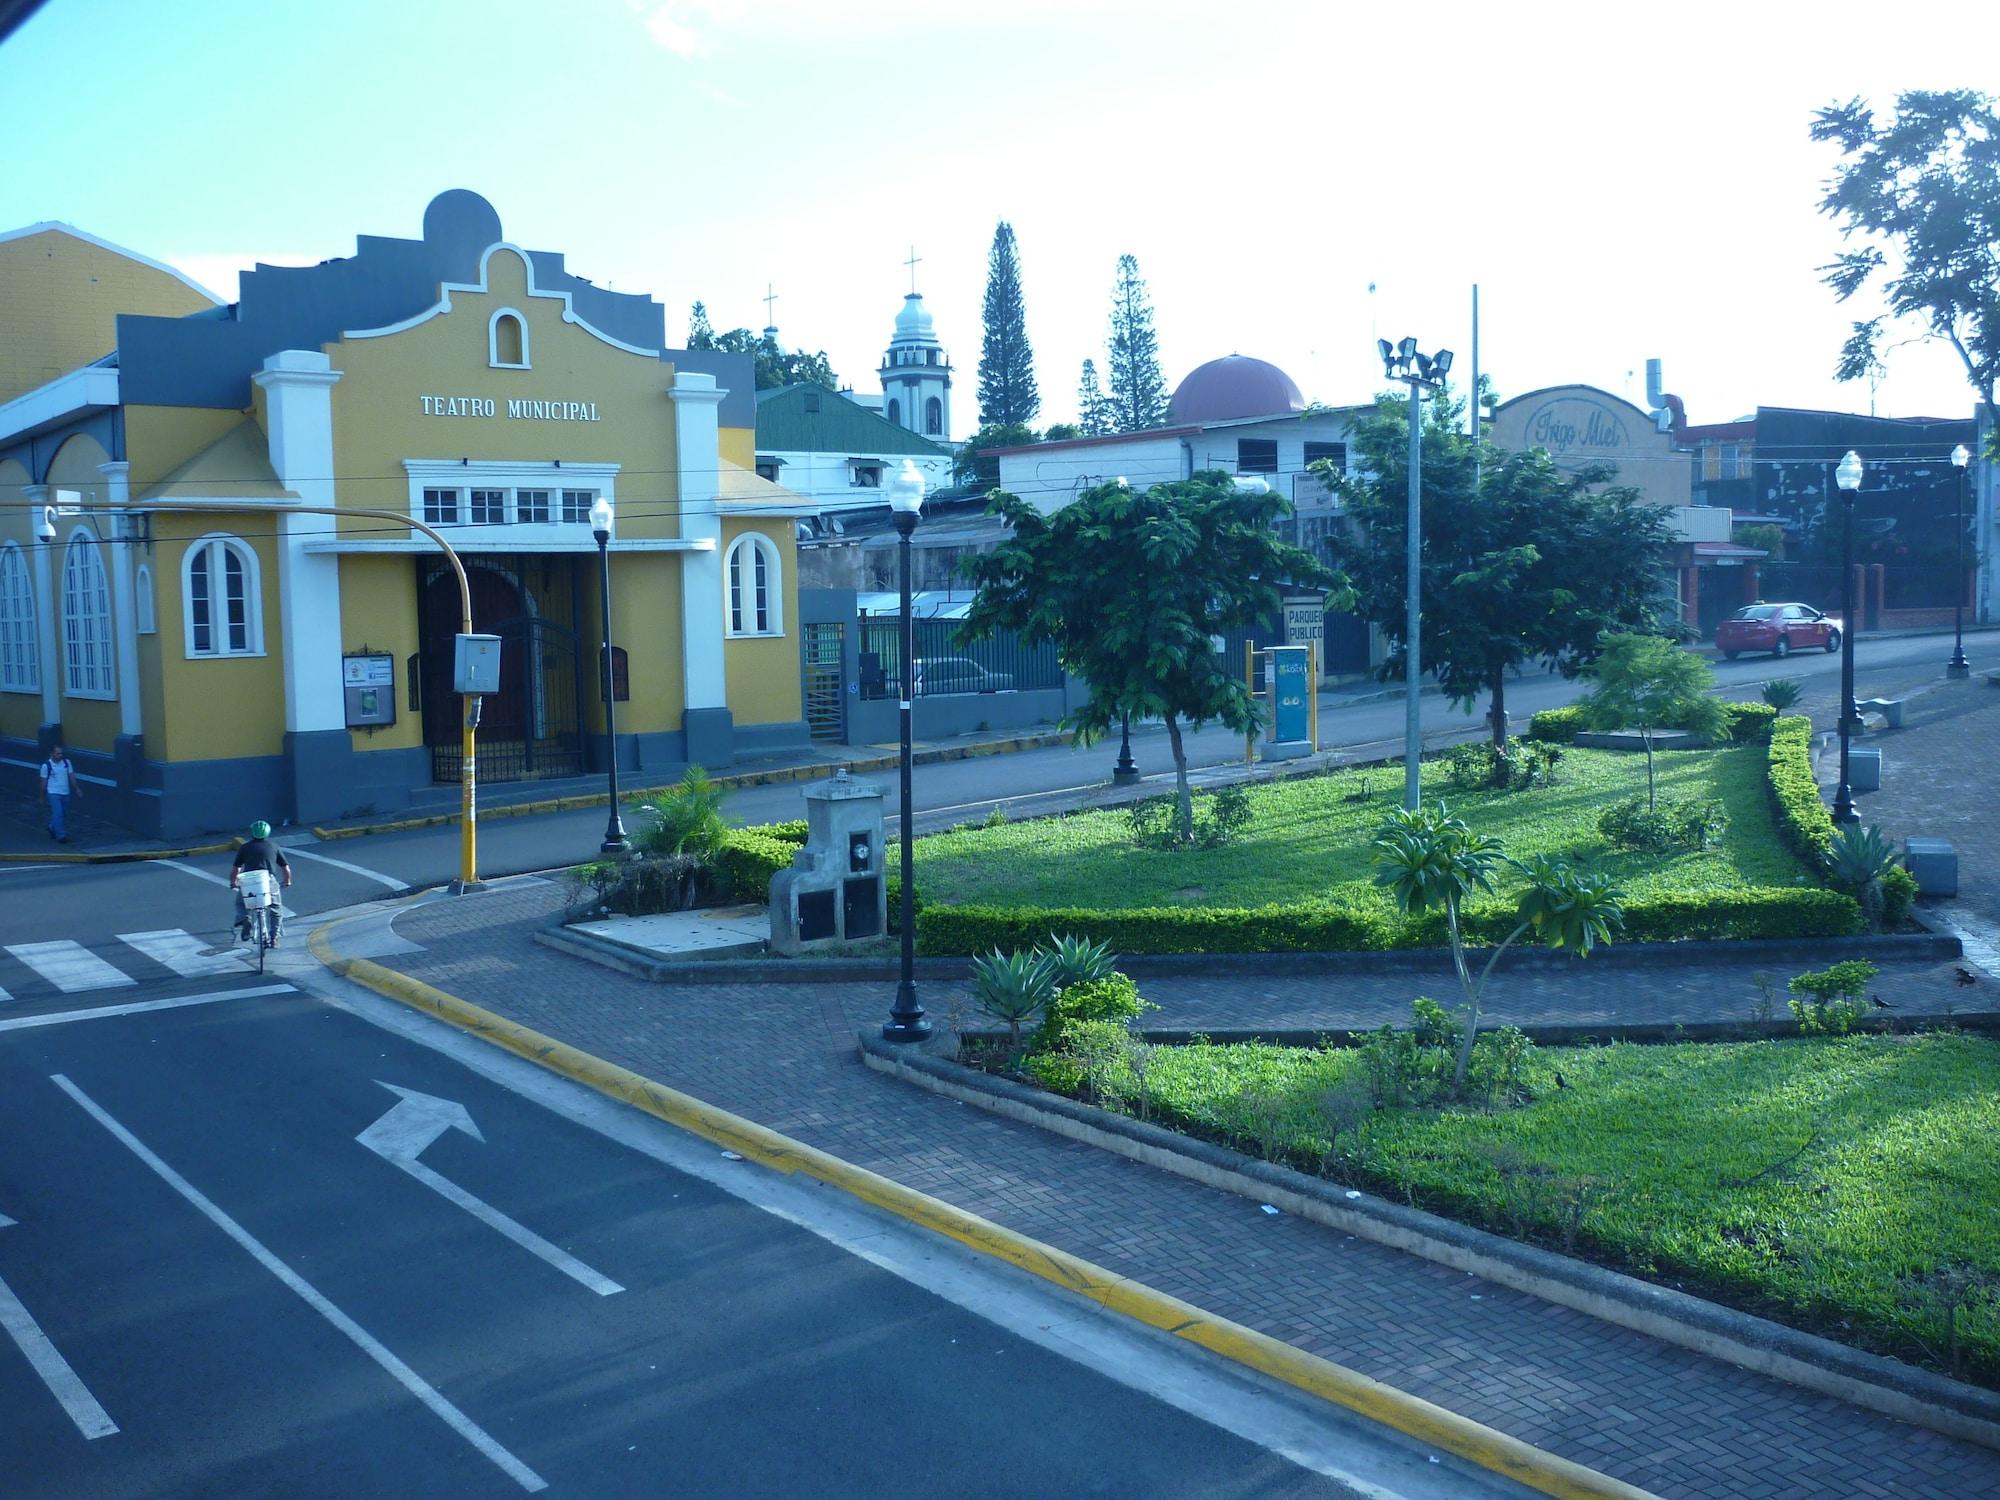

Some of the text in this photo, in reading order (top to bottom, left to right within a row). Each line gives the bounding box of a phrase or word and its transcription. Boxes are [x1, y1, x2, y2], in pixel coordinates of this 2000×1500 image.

[420, 395, 601, 422] TEATRO MUNICIPAL
[1535, 410, 1575, 453] Trigo
[1289, 610, 1323, 625] PARQUEO
[1289, 626, 1323, 641] PUBLICO
